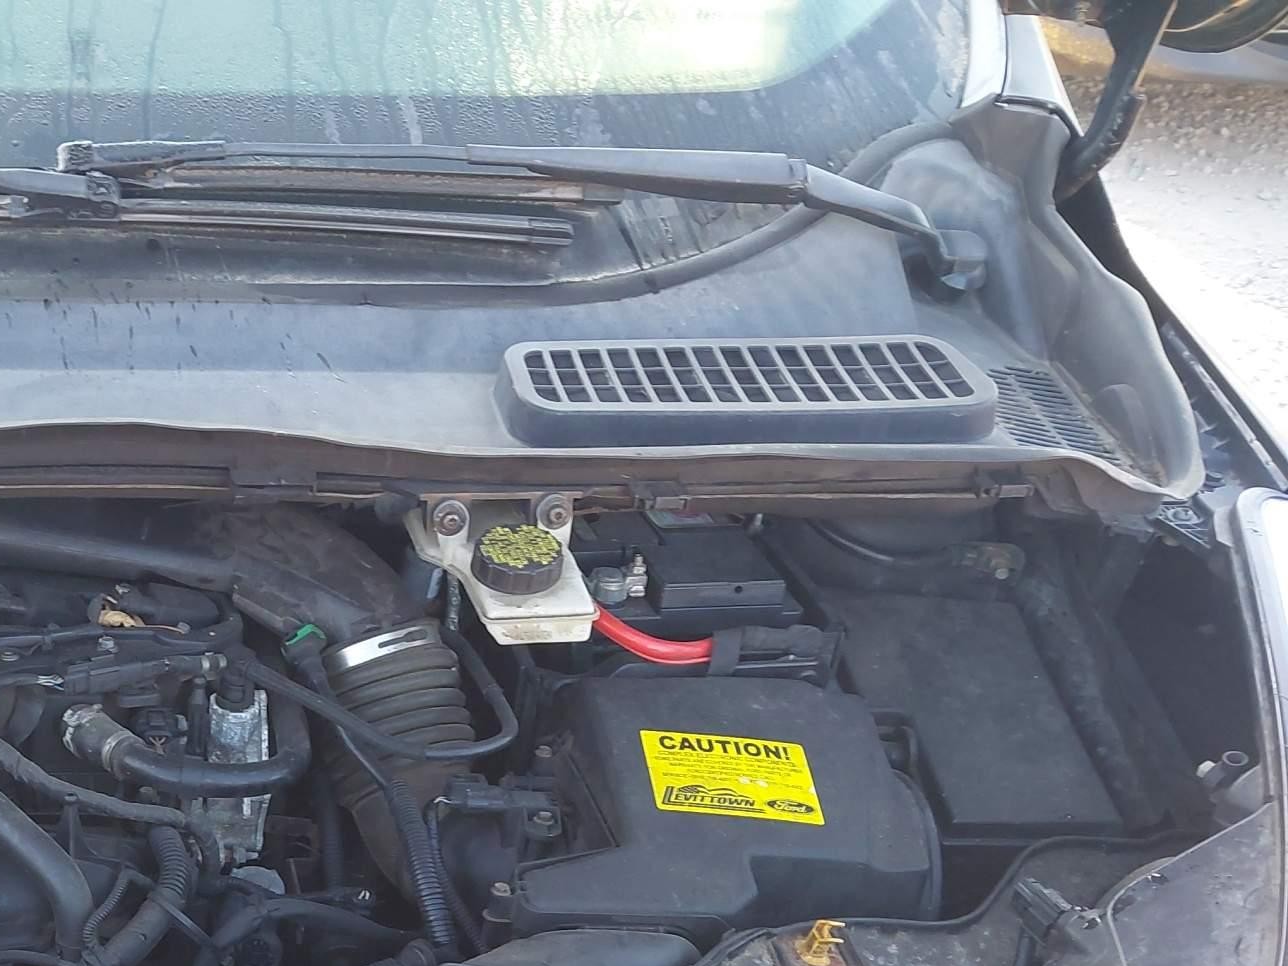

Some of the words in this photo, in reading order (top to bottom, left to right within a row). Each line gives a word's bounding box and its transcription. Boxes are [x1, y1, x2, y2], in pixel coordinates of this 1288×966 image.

[659, 735, 790, 761] CAUTION!
[662, 785, 756, 808] LEVITTOWN
[772, 799, 809, 814] Ford
